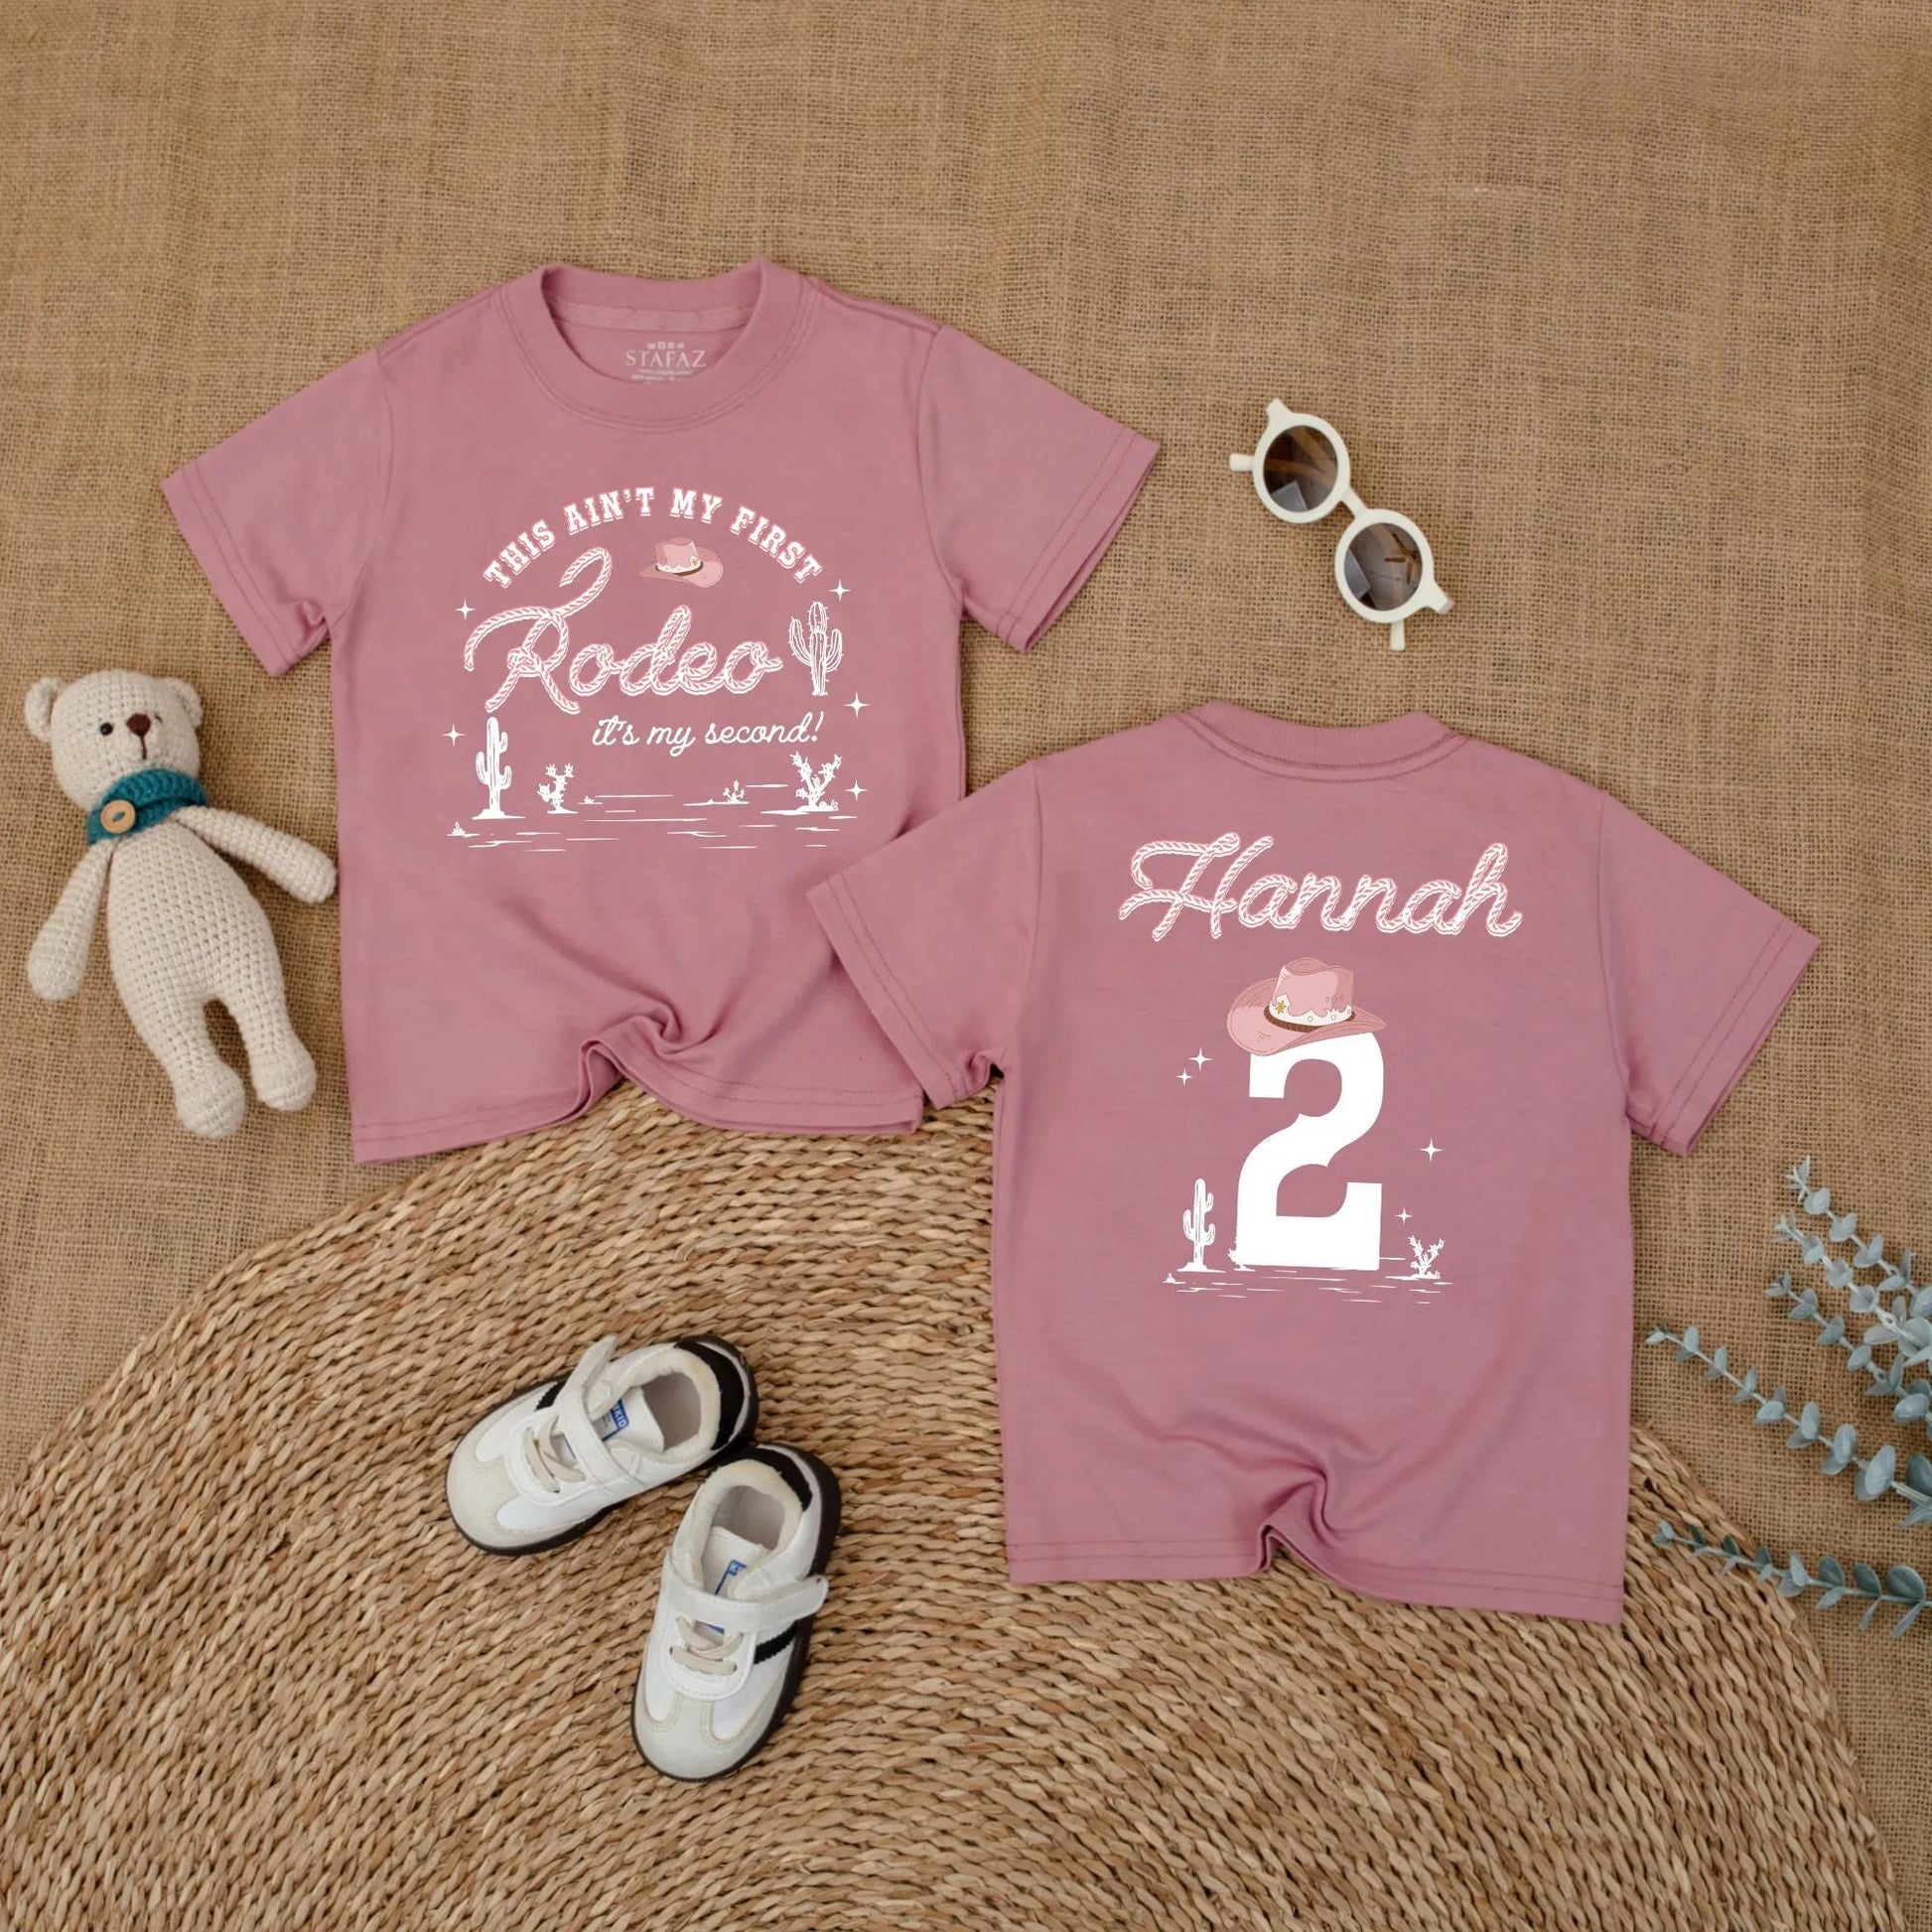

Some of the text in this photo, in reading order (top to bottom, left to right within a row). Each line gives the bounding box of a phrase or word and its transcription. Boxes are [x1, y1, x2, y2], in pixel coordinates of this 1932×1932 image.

[625, 349, 707, 367] STAFAZ
[483, 486, 823, 589] THIS AIN'T MY FIRST
[464, 547, 783, 715] Rodeo
[592, 711, 825, 758] it's my second!
[1119, 832, 1523, 941] Hannah
[1235, 1033, 1384, 1270] 2
